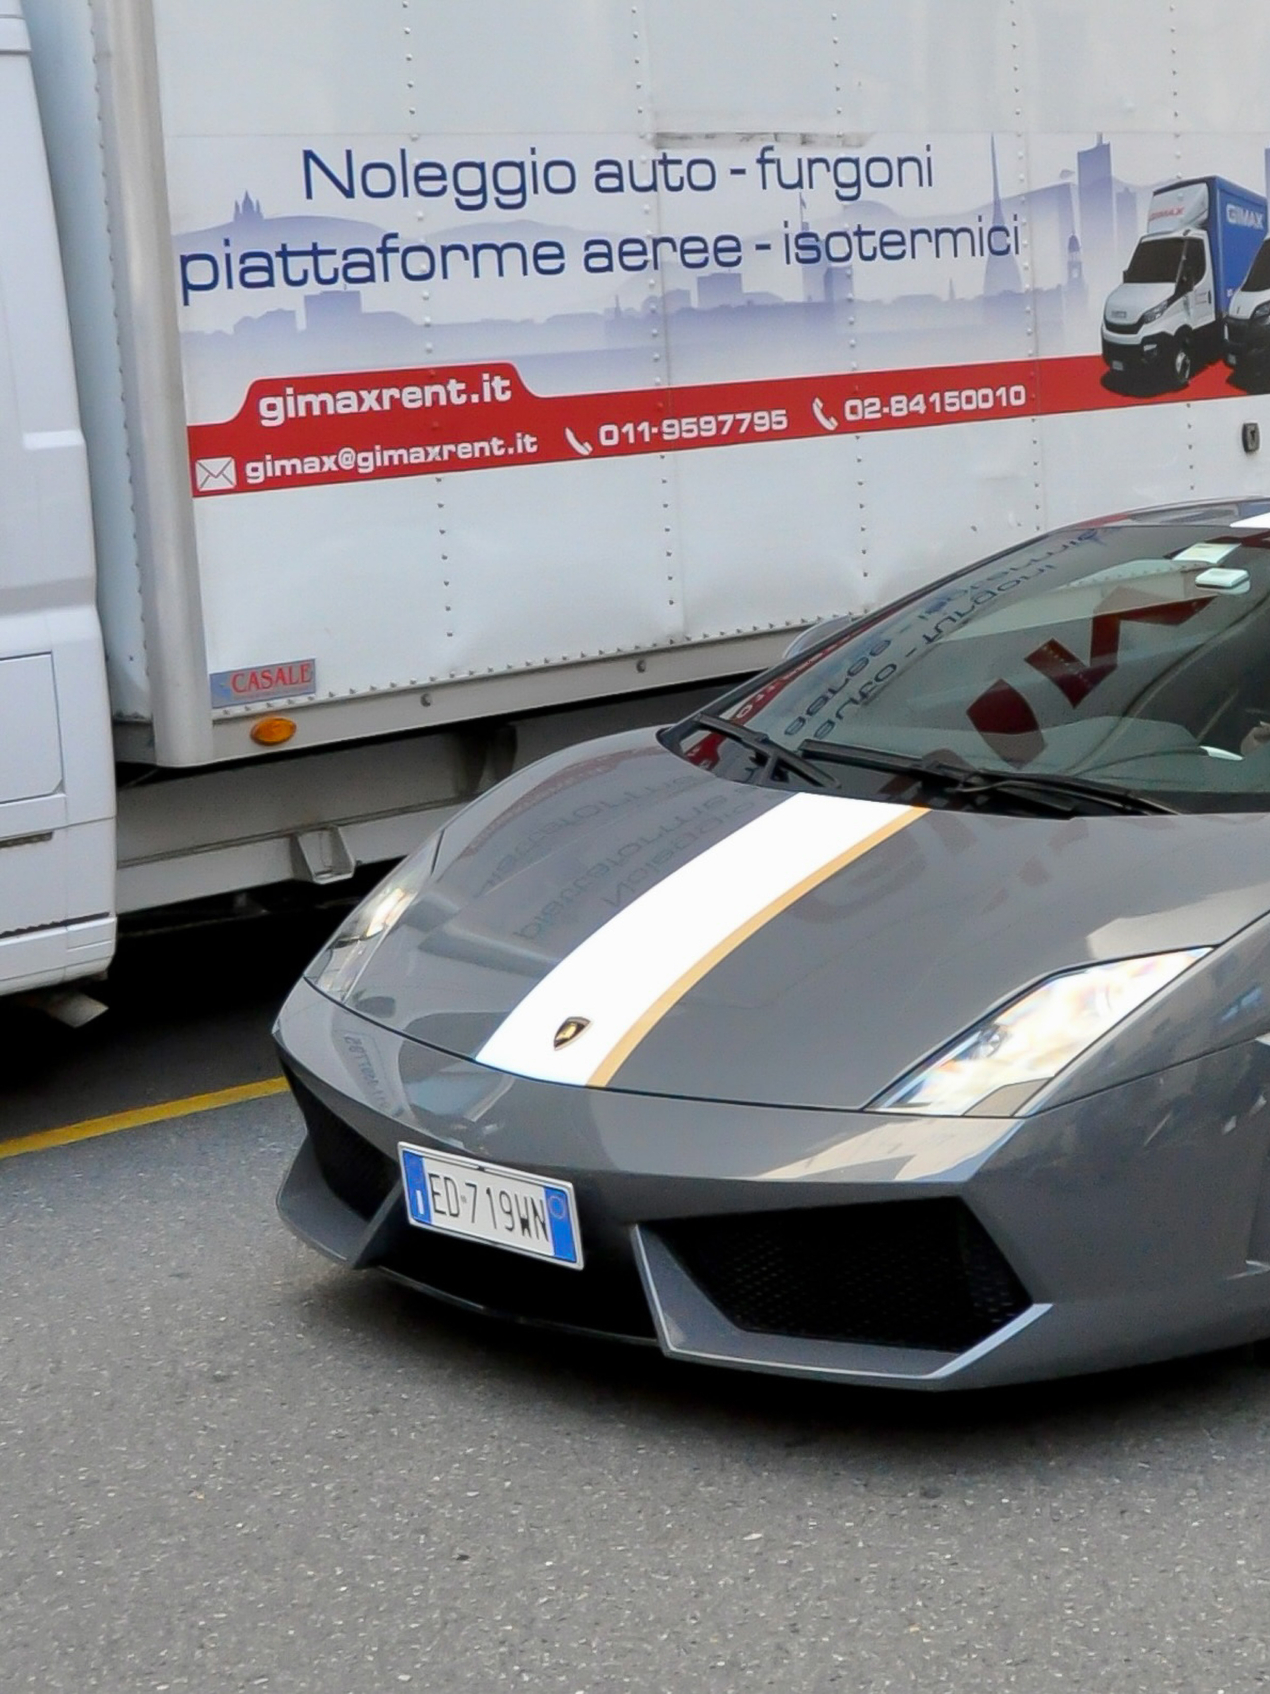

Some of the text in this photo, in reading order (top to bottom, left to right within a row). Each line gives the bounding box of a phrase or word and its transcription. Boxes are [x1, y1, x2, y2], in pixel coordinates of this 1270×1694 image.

[302, 146, 577, 212] Noleggio
[594, 150, 717, 194] auto
[756, 143, 934, 202] furgoni
[1226, 203, 1265, 231] GIMAX
[179, 232, 566, 307] piattaforme
[583, 232, 744, 274] aeree
[783, 213, 1021, 265] isotermici
[258, 373, 513, 427] gimaxrent.it
[843, 384, 1027, 422] 02-84150010
[599, 409, 788, 448] 011-9597795
[245, 432, 539, 484] gimax@gimaxrent.it
[230, 663, 312, 694] CASALE
